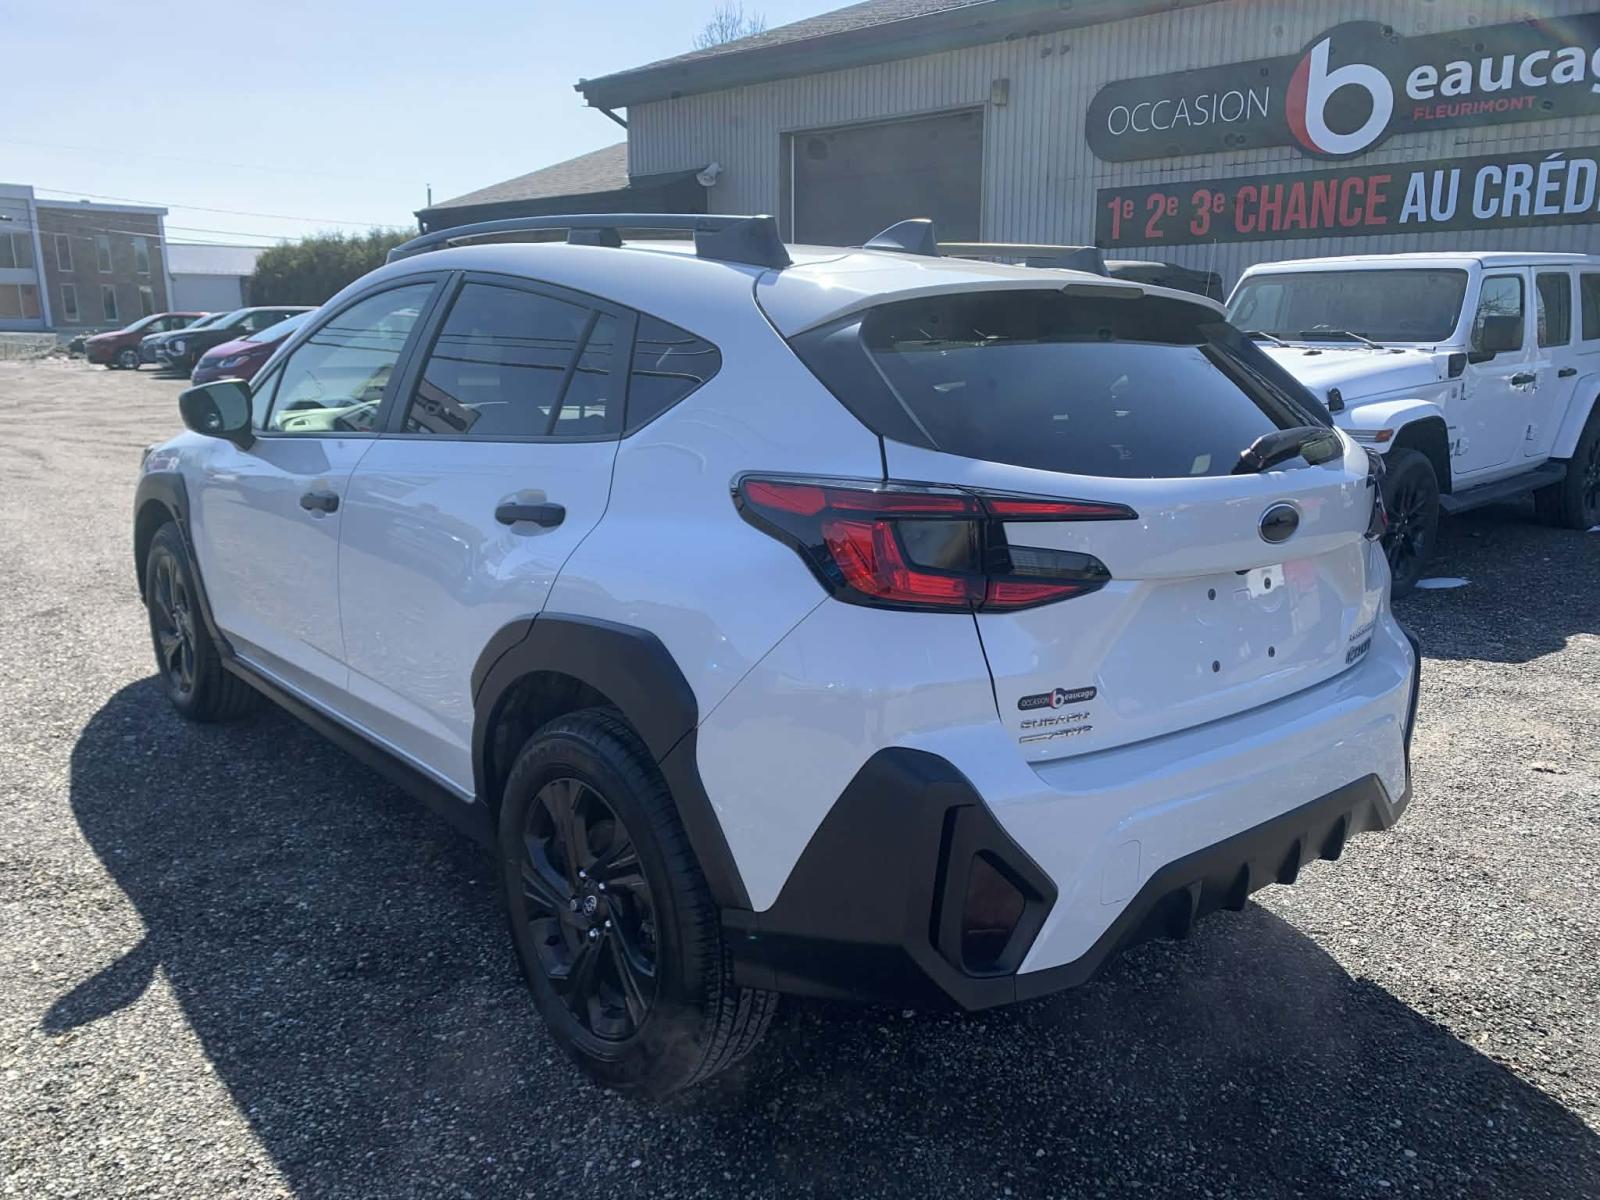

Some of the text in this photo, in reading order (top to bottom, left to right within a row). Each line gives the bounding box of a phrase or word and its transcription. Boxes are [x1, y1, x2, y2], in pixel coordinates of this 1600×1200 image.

[1107, 86, 1270, 136] OCCASION
[1413, 95, 1537, 121] FLEURIMONT
[1144, 192, 1180, 239] 2e
[1189, 188, 1226, 237] 3e
[1233, 174, 1392, 233] CHANCE
[1399, 168, 1461, 224] AU
[1471, 152, 1600, 220] CRÉD
